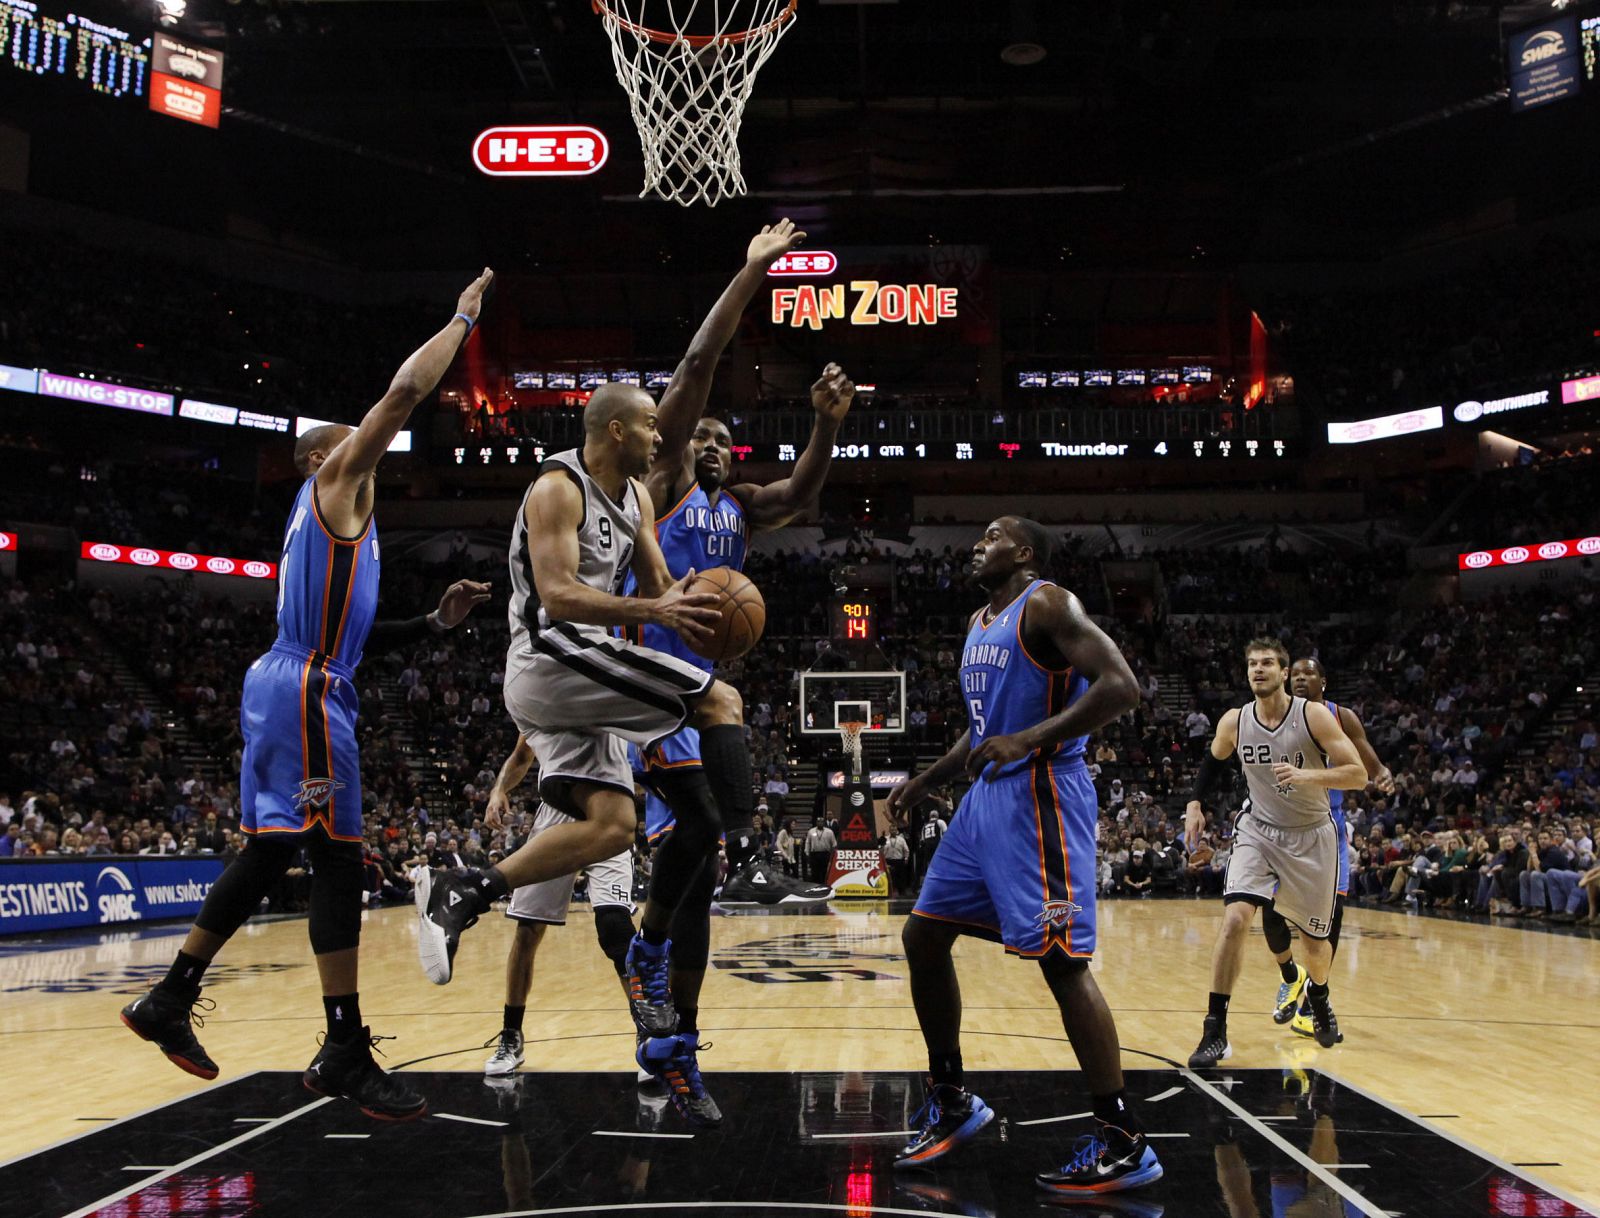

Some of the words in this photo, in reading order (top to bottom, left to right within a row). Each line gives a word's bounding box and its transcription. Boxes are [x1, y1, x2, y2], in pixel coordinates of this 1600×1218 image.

[772, 285, 845, 329] FAN
[850, 281, 958, 325] ZONE
[1483, 391, 1548, 414] SOUTHWEST
[778, 445, 795, 453] TOL
[879, 446, 904, 456] QTR
[915, 444, 925, 457] 1
[956, 443, 972, 451] TOL
[1041, 442, 1128, 456] Thunder
[1154, 441, 1167, 455] 4
[1193, 441, 1203, 449] ST
[1219, 441, 1231, 449] AS
[1246, 440, 1258, 449] RB
[1274, 440, 1285, 449] BL
[455, 448, 465, 456] ST
[480, 448, 492, 456] AS
[534, 447, 545, 455] BL
[1195, 449, 1202, 457] 0
[1223, 449, 1229, 457] 2
[1250, 449, 1256, 457] 5
[456, 456, 462, 464] 0
[483, 456, 489, 464] 2
[510, 455, 516, 463] 5
[536, 455, 543, 463] 0
[598, 516, 611, 549] 9
[707, 534, 734, 557] CIT
[1542, 544, 1564, 557] KIA
[94, 546, 116, 559] KIA
[134, 551, 155, 563] KIA
[1505, 549, 1526, 561] KIA
[173, 555, 194, 567] KIA
[210, 559, 231, 571] KIA
[1469, 554, 1489, 566] KIA
[246, 563, 267, 576] KIA
[843, 604, 869, 617] 9:01
[848, 619, 866, 638] 14
[961, 645, 1010, 669] LAHOMA
[965, 672, 987, 693] CITY
[970, 699, 986, 737] 5
[1242, 744, 1272, 764] 22
[837, 850, 880, 860] BRAKE
[835, 860, 881, 870] CHECK
[611, 883, 629, 902] SA
[0, 881, 89, 918] ESTMENTS
[97, 894, 141, 923] SWBC
[144, 878, 215, 905] www.swbc.c
[1308, 917, 1327, 933] SA
